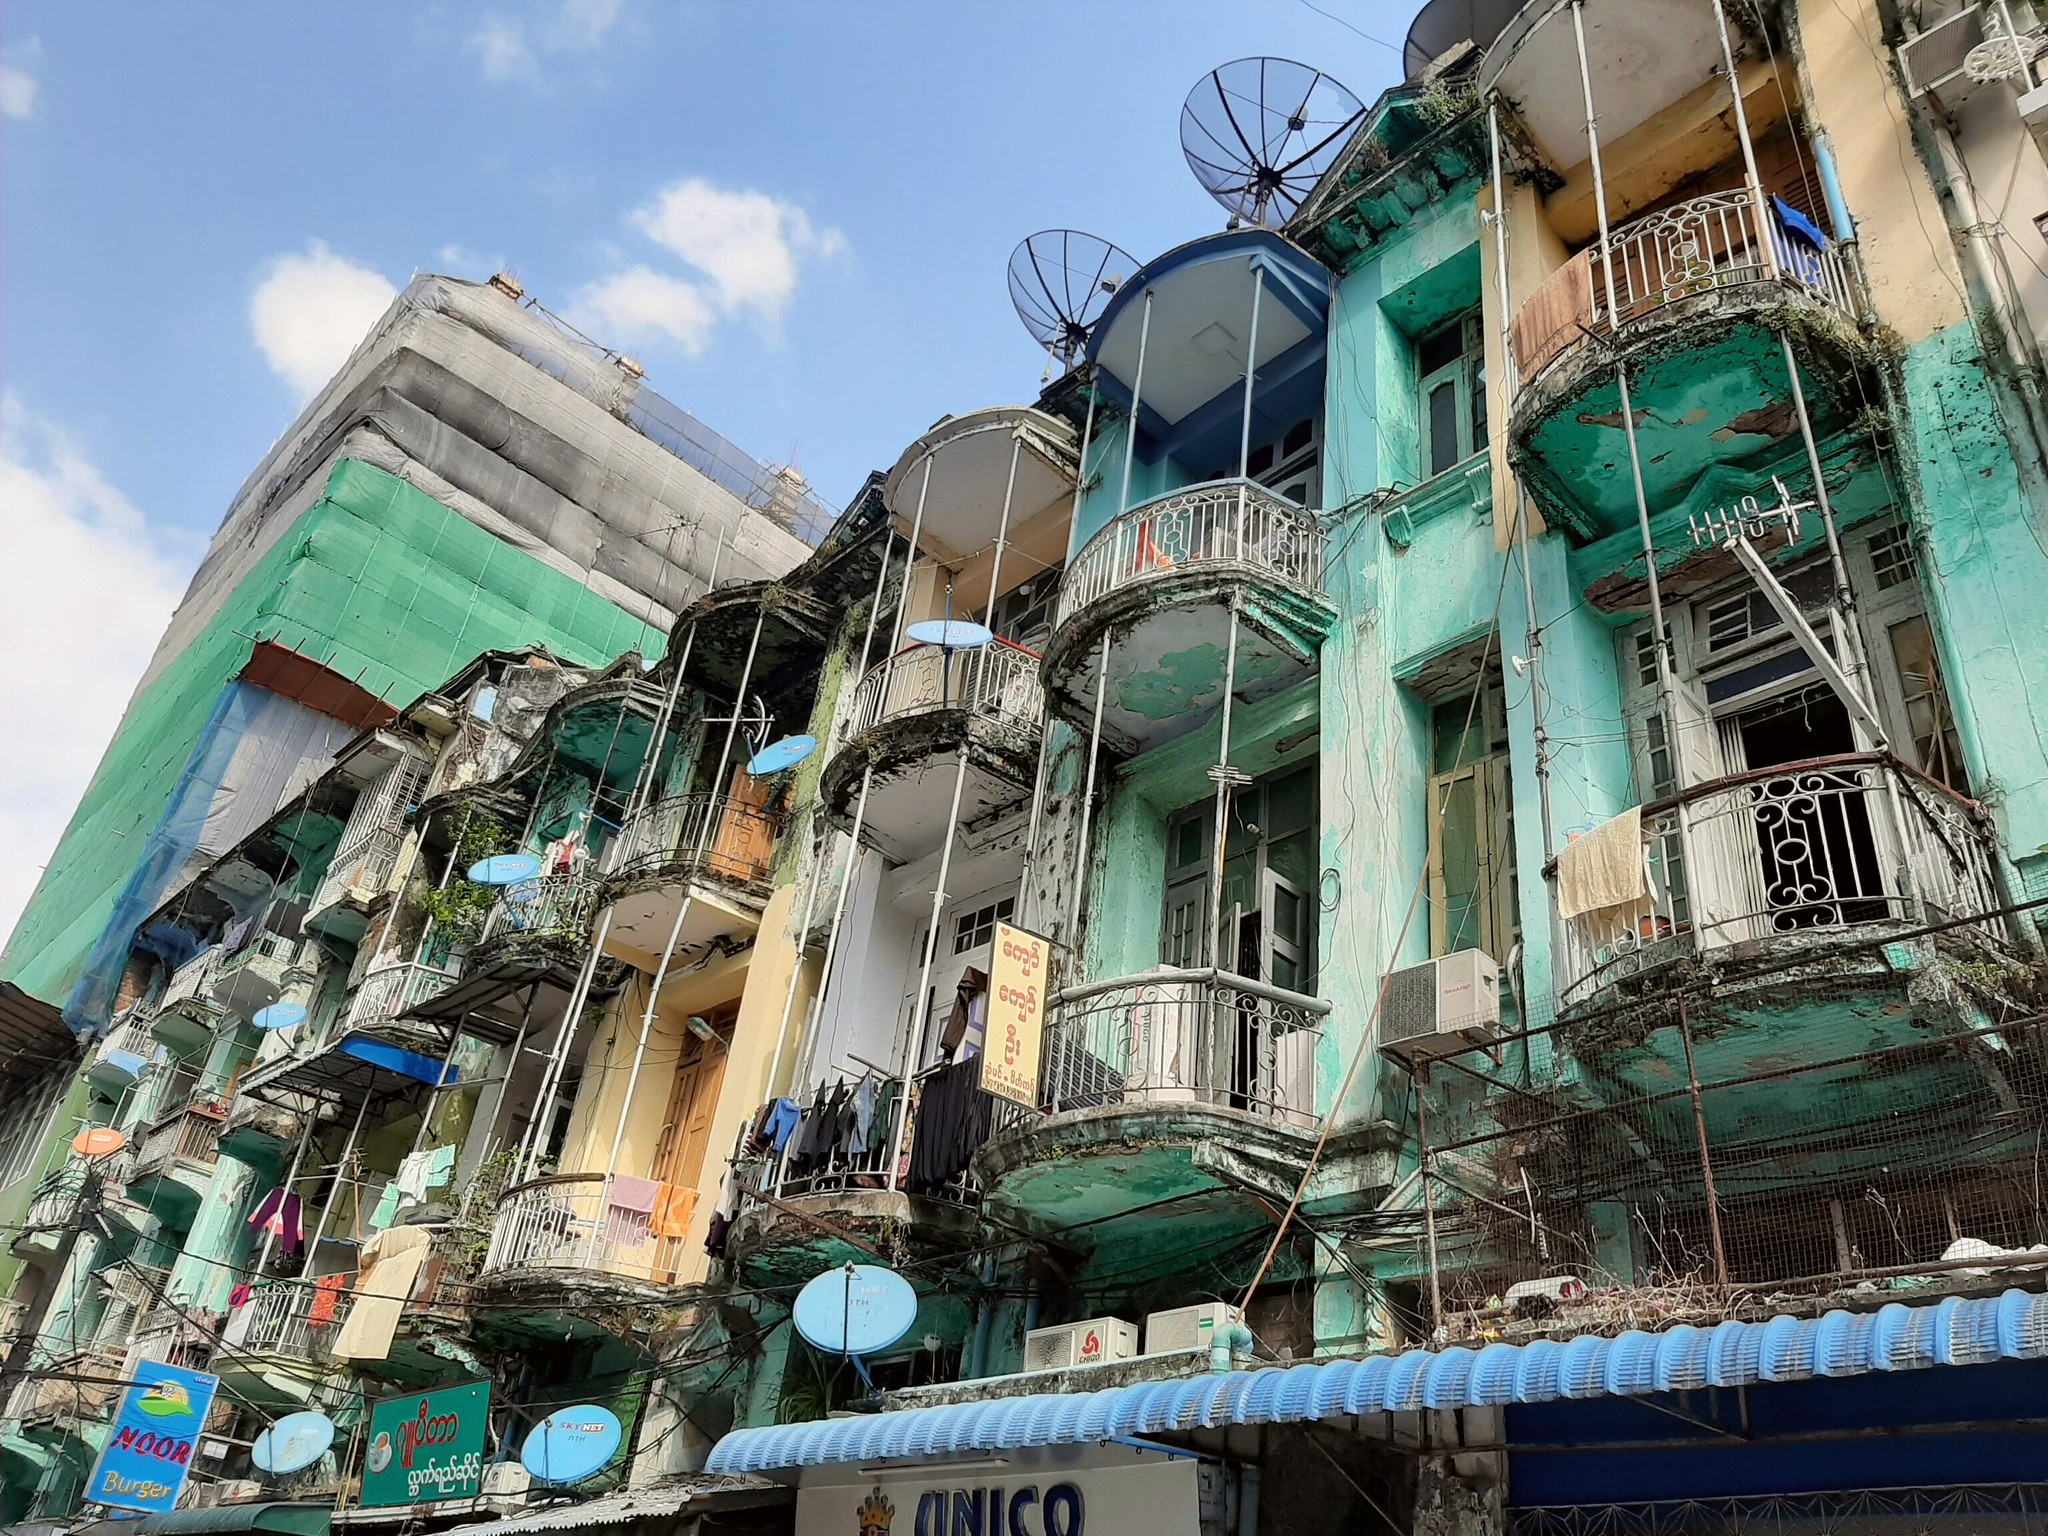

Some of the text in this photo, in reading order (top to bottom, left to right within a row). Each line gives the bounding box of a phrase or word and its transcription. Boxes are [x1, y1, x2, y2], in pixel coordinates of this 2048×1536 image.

[110, 1425, 192, 1466] NOOR
[102, 1470, 172, 1501] Burger
[914, 1482, 1086, 1536] UNICO
